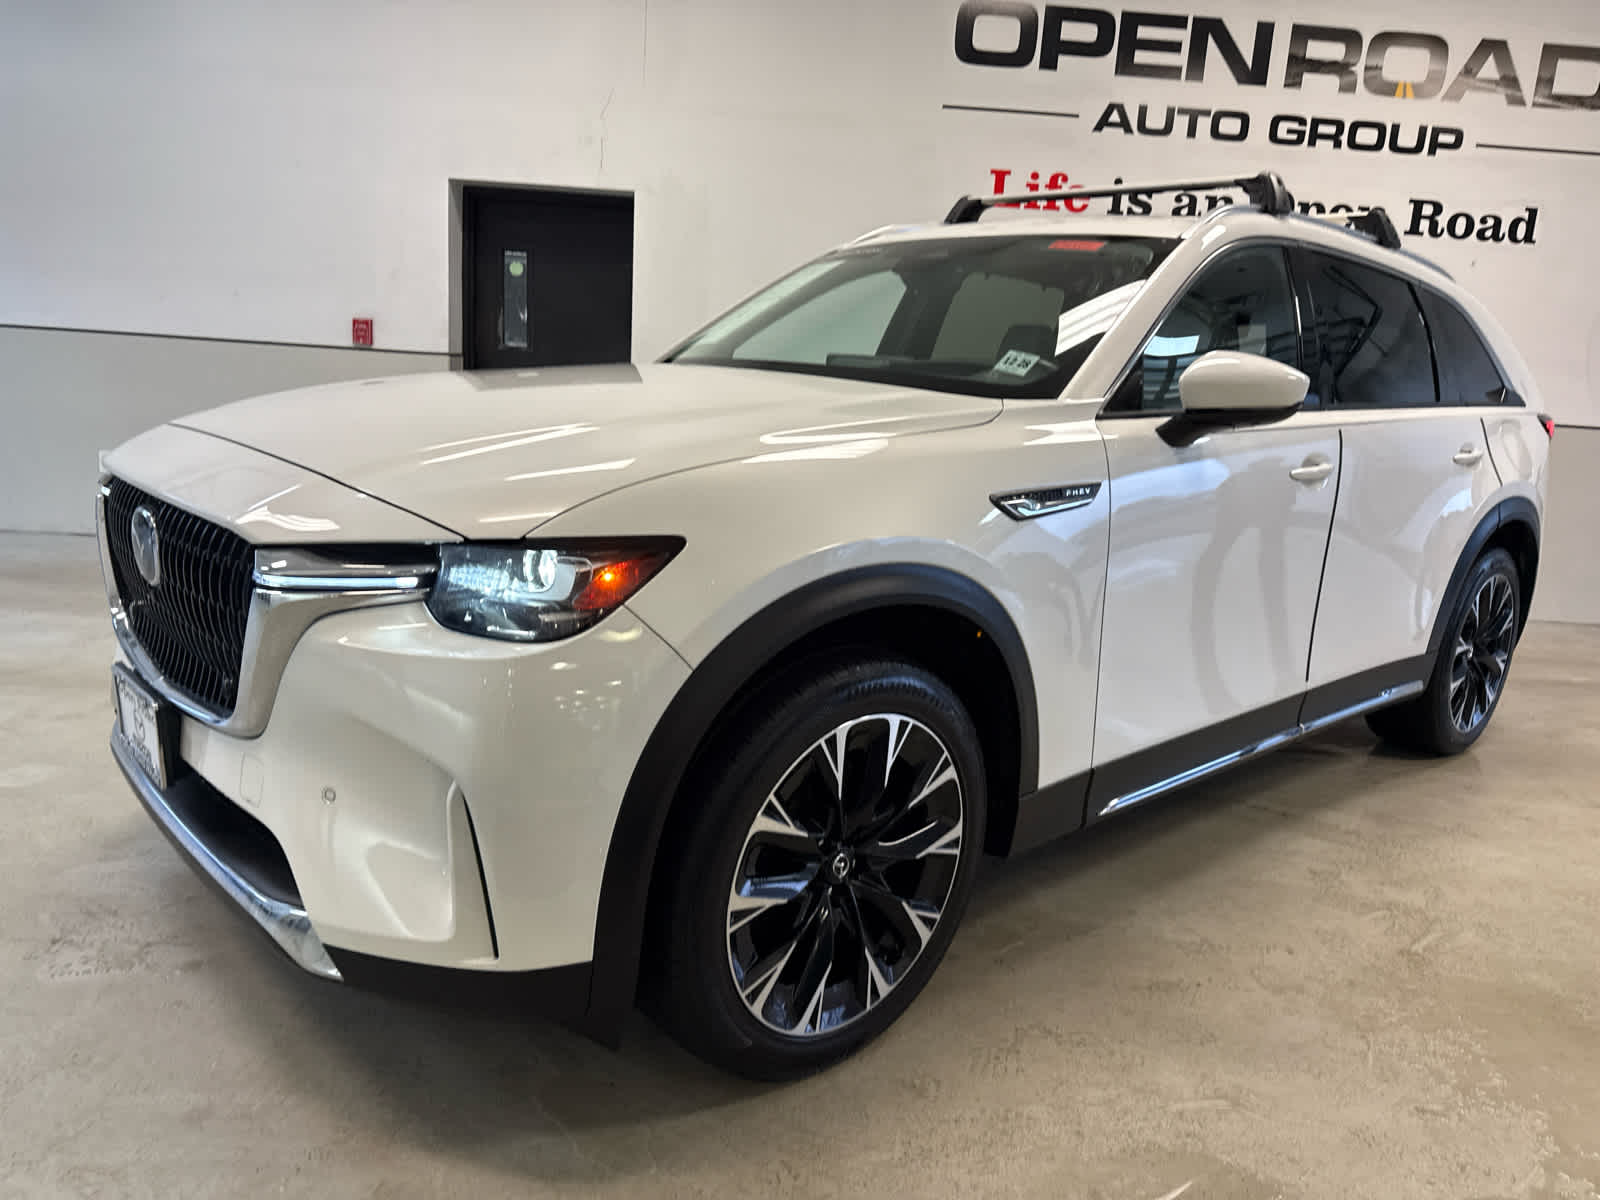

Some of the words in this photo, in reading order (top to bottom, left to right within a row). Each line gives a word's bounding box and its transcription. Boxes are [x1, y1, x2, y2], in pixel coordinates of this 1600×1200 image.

[955, 0, 1275, 87] OPEN
[1284, 23, 1600, 112] ROAD
[1092, 101, 1250, 142] AUTO
[1268, 114, 1465, 157] GROUP
[990, 169, 1091, 213] Life
[1107, 178, 1152, 216] is
[1404, 198, 1538, 245] Road
[1066, 487, 1091, 497] PHEV
